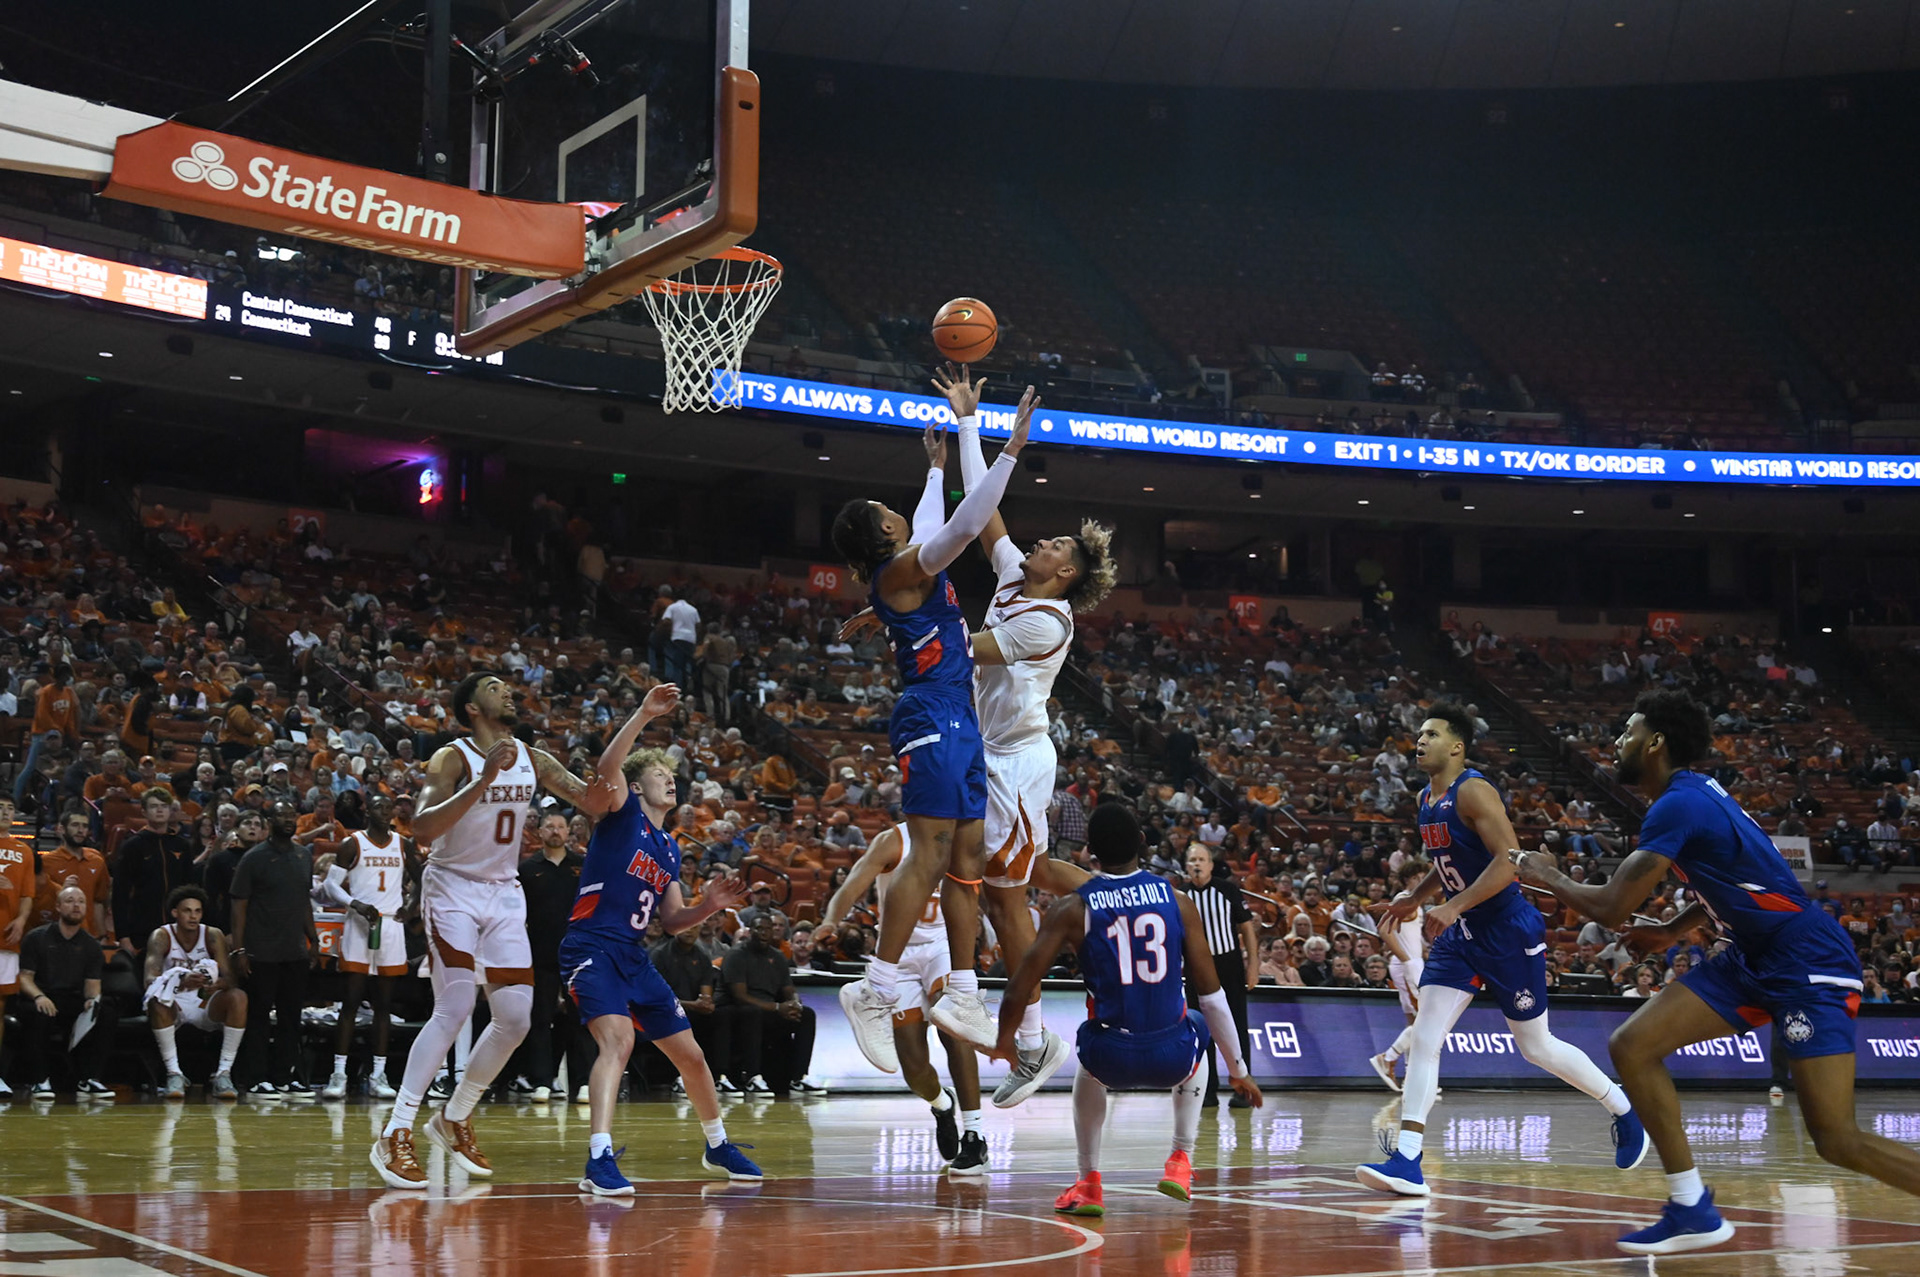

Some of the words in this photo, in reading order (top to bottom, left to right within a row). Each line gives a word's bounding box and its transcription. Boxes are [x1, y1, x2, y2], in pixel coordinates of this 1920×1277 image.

[409, 331, 416, 345] F
[782, 386, 872, 413] ALWAYS
[878, 399, 894, 416] A
[1069, 420, 1148, 443] WINSTAR
[1152, 427, 1216, 448] WORLD
[1221, 432, 1288, 454] RESORT
[1335, 442, 1383, 460] EXIT
[1388, 445, 1396, 461] 1
[1419, 447, 1458, 465] I-35
[1464, 449, 1479, 466] N
[1501, 451, 1570, 471] TX/OK
[1576, 455, 1665, 473] BORDER
[1712, 459, 1792, 476] WINSTAR
[1796, 461, 1863, 477] WORLD
[813, 571, 837, 590] 49
[1653, 618, 1675, 633] 47
[480, 784, 533, 803] TEXAS
[494, 809, 515, 845] 0
[363, 856, 400, 867] TEXAS
[626, 849, 672, 894] HBU
[1433, 855, 1466, 892] 15
[378, 871, 386, 892] 1
[630, 890, 655, 930] 3
[1107, 913, 1167, 985] 13
[1445, 1032, 1514, 1053] TRUIST
